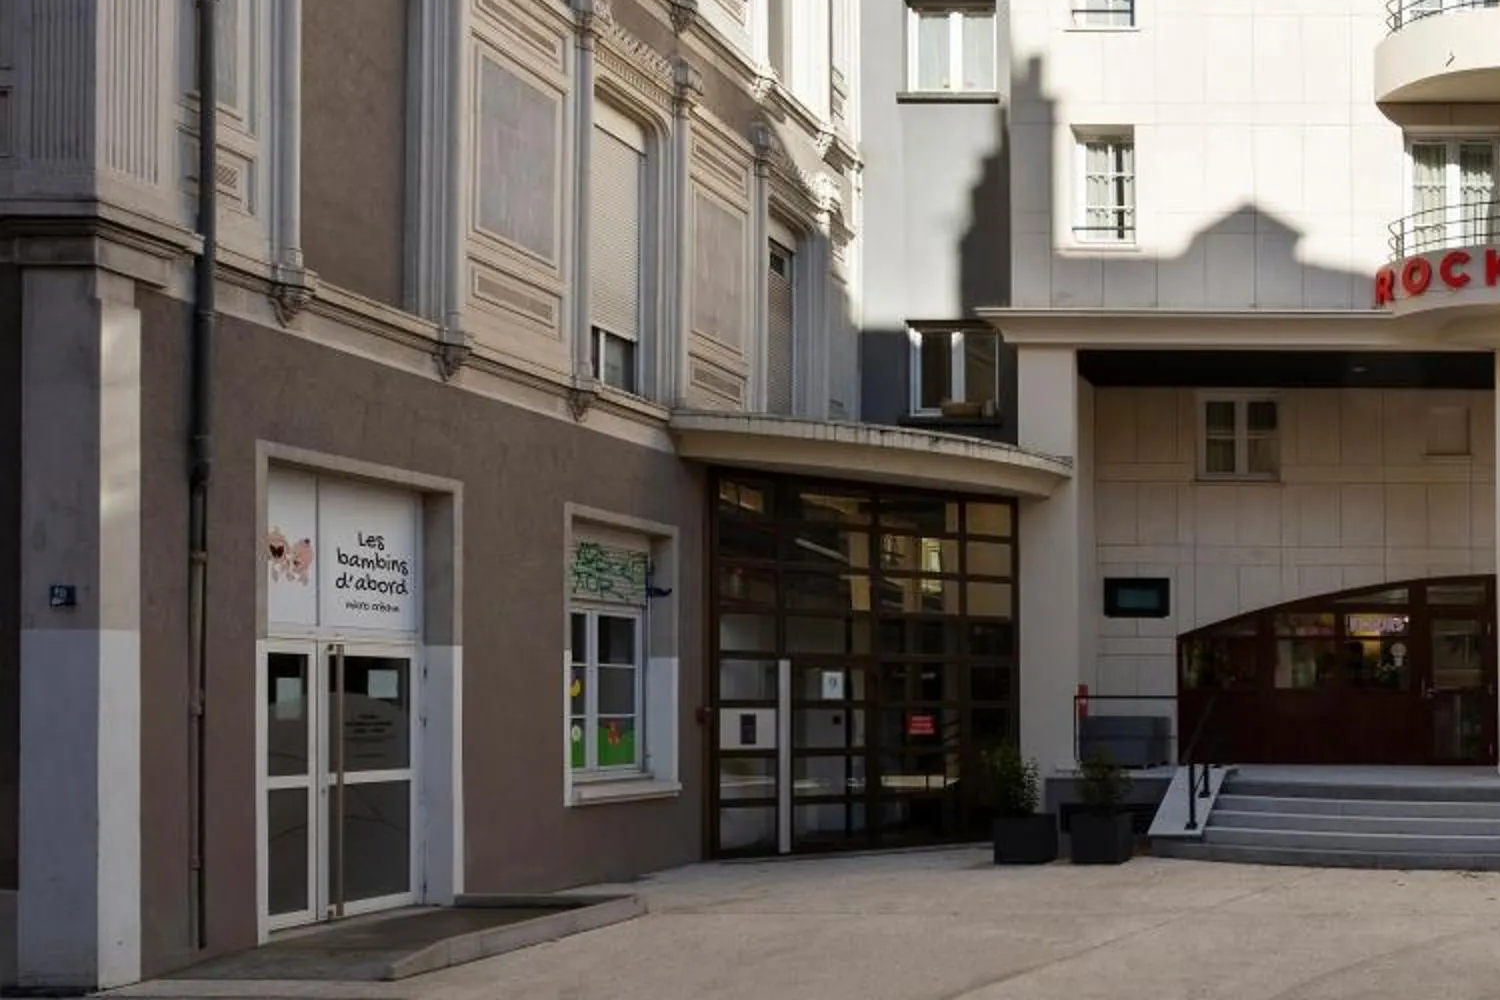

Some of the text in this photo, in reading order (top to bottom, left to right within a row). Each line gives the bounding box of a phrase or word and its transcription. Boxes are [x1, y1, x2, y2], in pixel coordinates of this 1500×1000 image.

[358, 531, 385, 550] Les
[337, 547, 409, 576] bambins
[335, 572, 408, 595] d'abord
